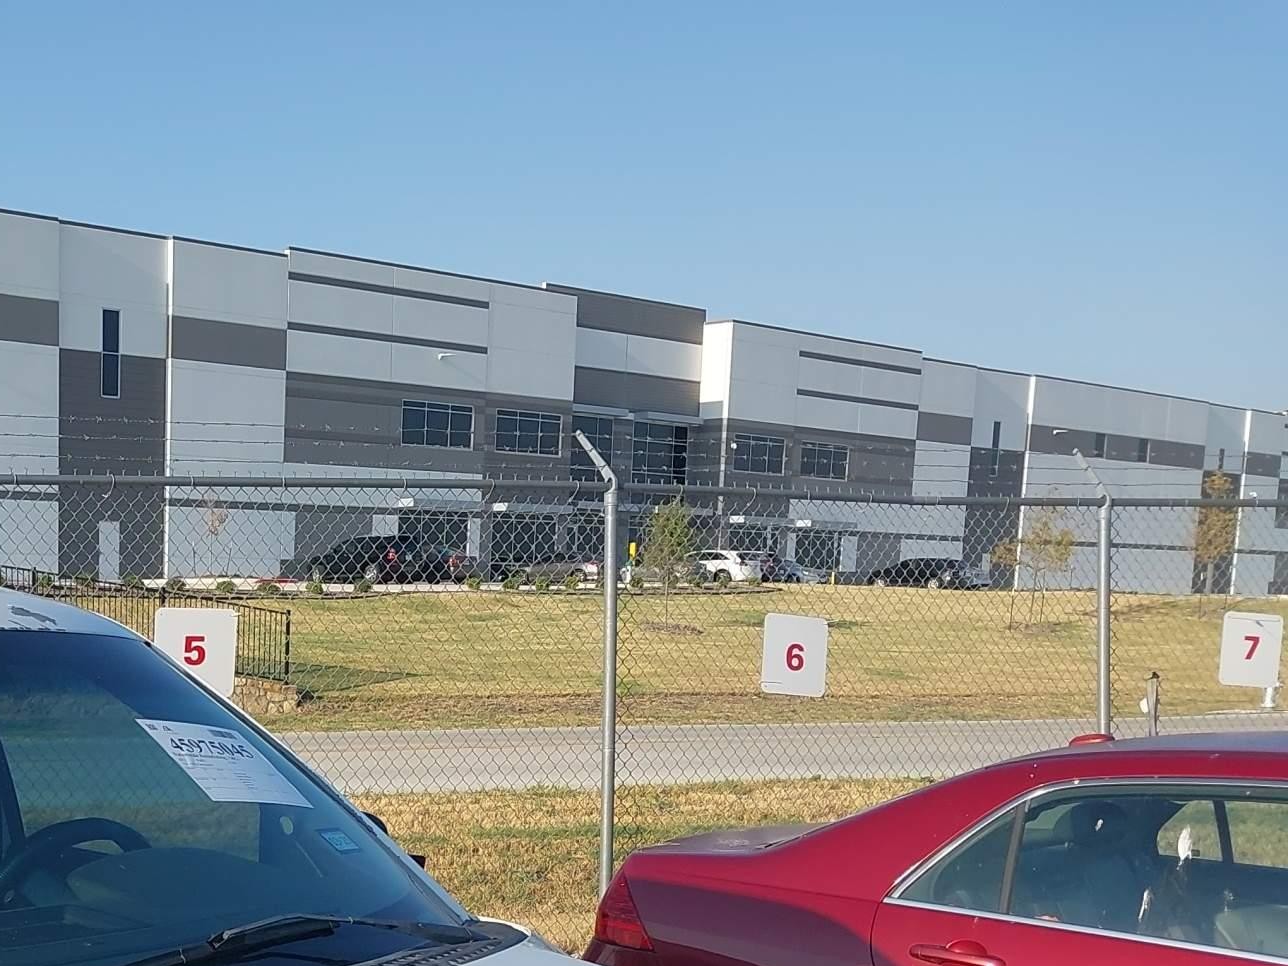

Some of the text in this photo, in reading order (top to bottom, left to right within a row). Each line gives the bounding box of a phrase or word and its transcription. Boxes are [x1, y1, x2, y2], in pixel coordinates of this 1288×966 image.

[184, 636, 207, 667] 5
[786, 643, 805, 671] 6
[1244, 636, 1260, 659] 7
[169, 737, 255, 760] 45975045
